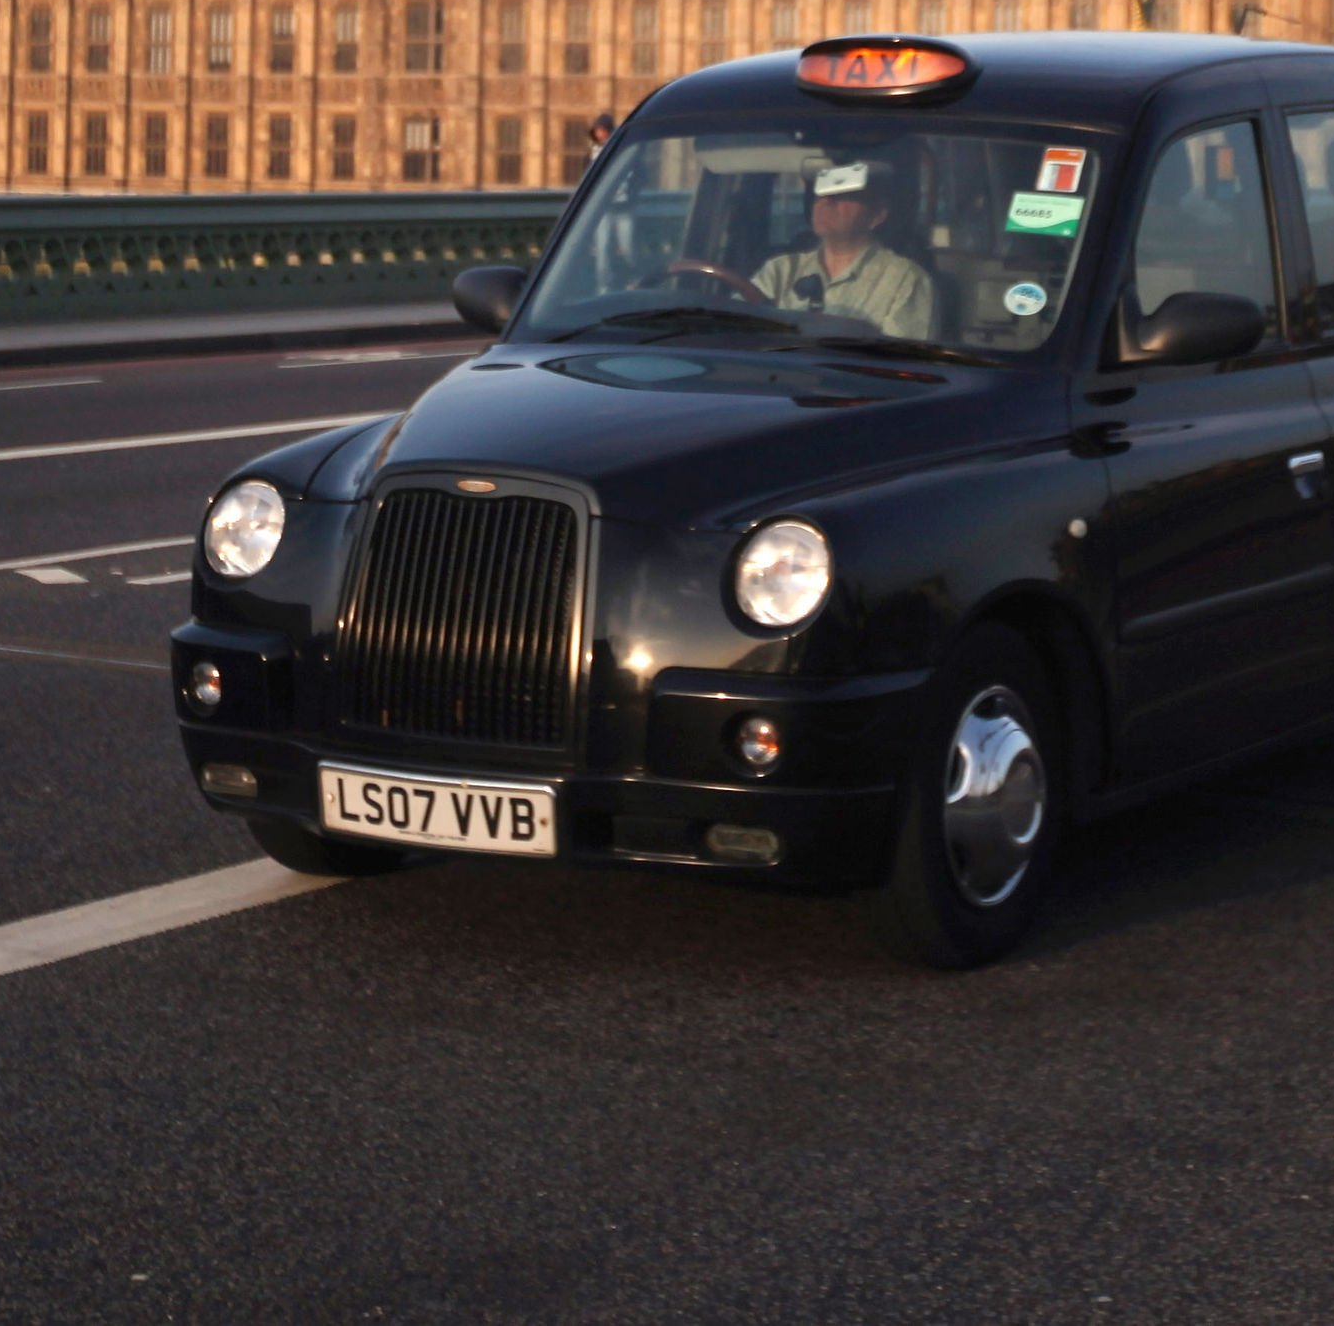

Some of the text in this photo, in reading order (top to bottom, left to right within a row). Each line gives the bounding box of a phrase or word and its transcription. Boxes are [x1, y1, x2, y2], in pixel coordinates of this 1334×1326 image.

[827, 53, 918, 83] TAXI
[337, 778, 535, 842] LS07 VVB
